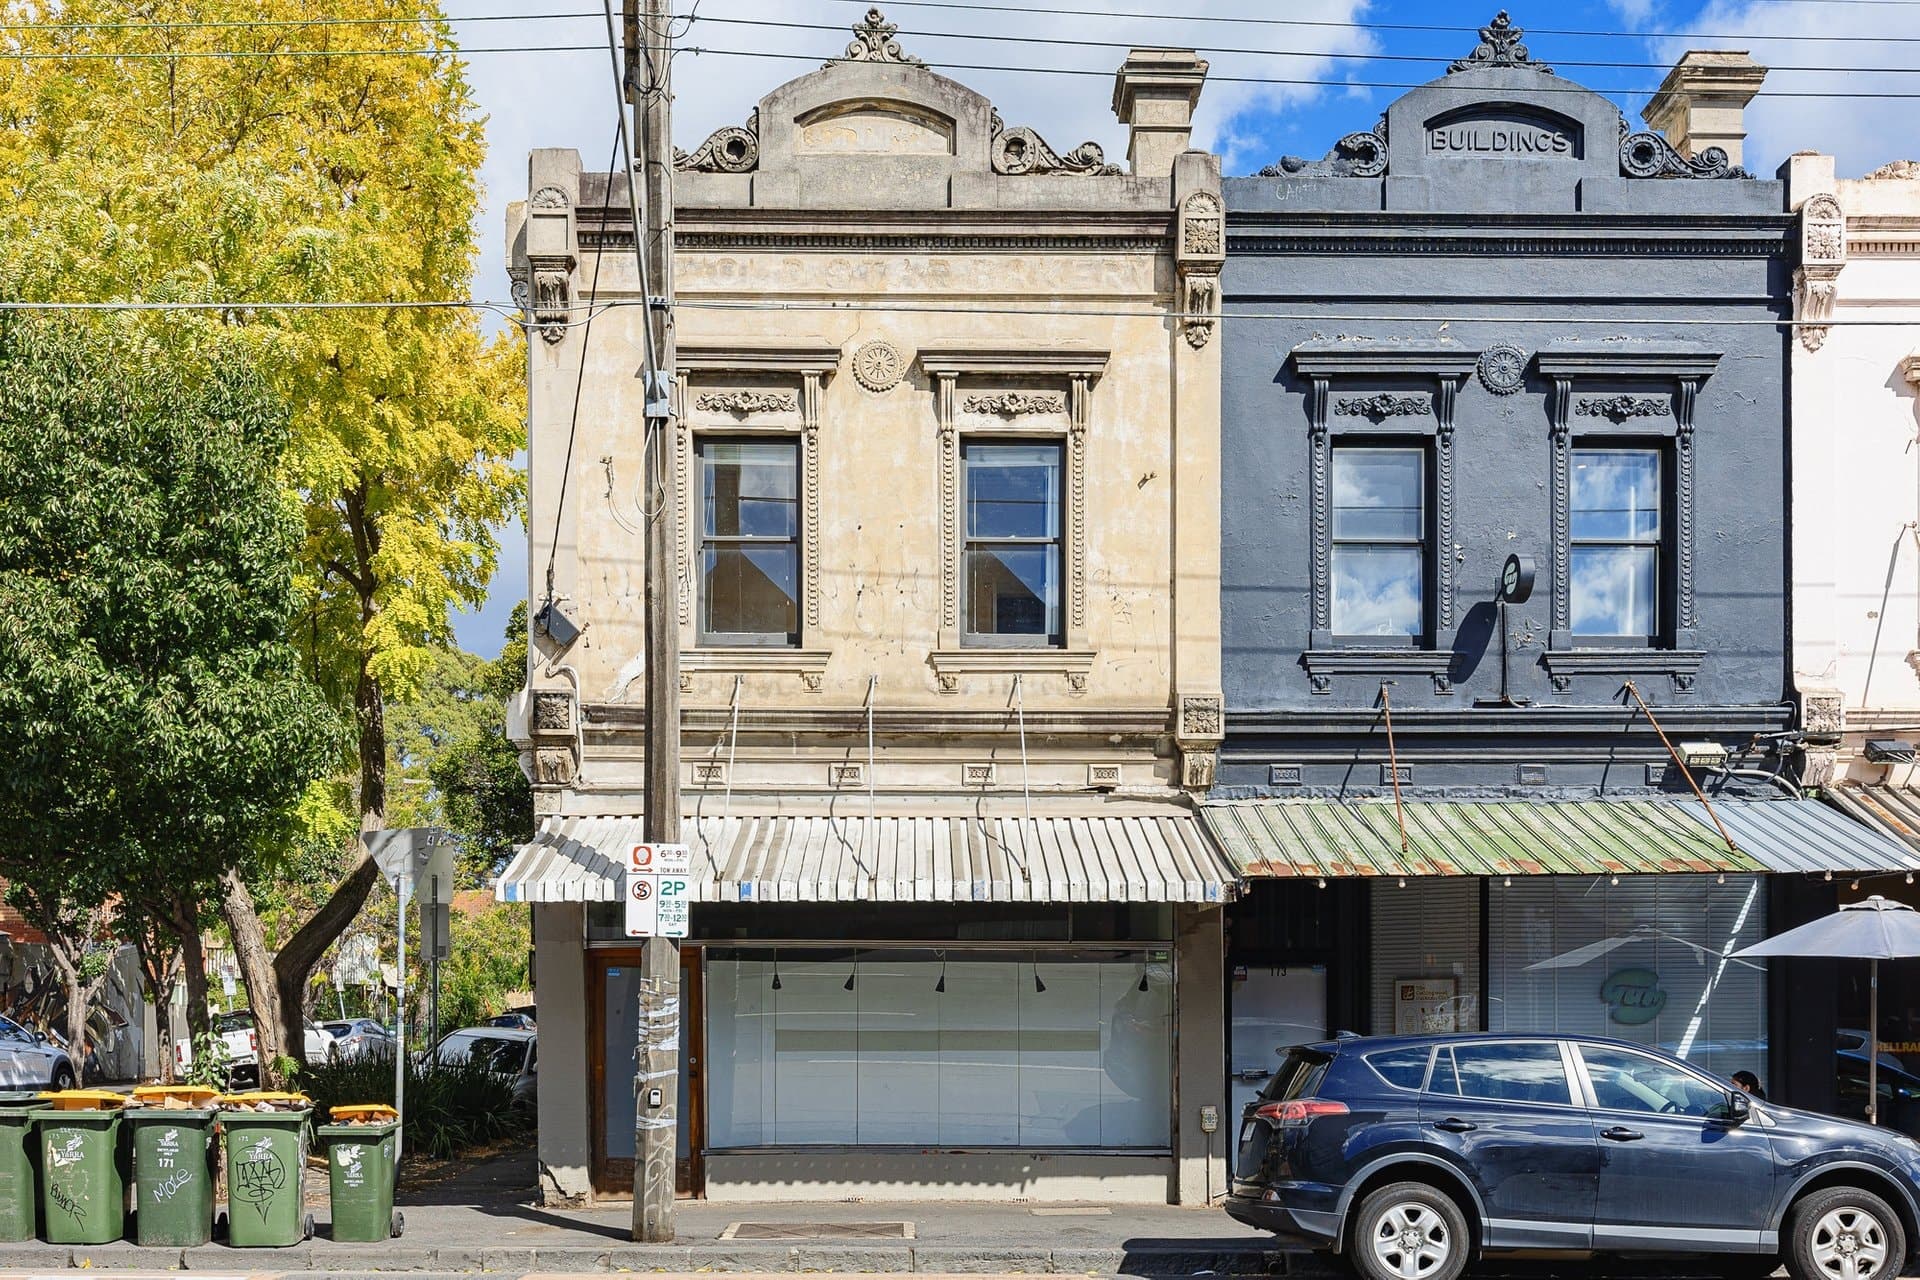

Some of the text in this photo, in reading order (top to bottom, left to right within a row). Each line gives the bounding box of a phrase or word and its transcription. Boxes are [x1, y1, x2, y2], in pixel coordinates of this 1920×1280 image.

[1431, 129, 1569, 153] BUILDINGS
[661, 881, 686, 896] 2P
[60, 1151, 84, 1159] YARRA
[158, 1158, 174, 1168] 171
